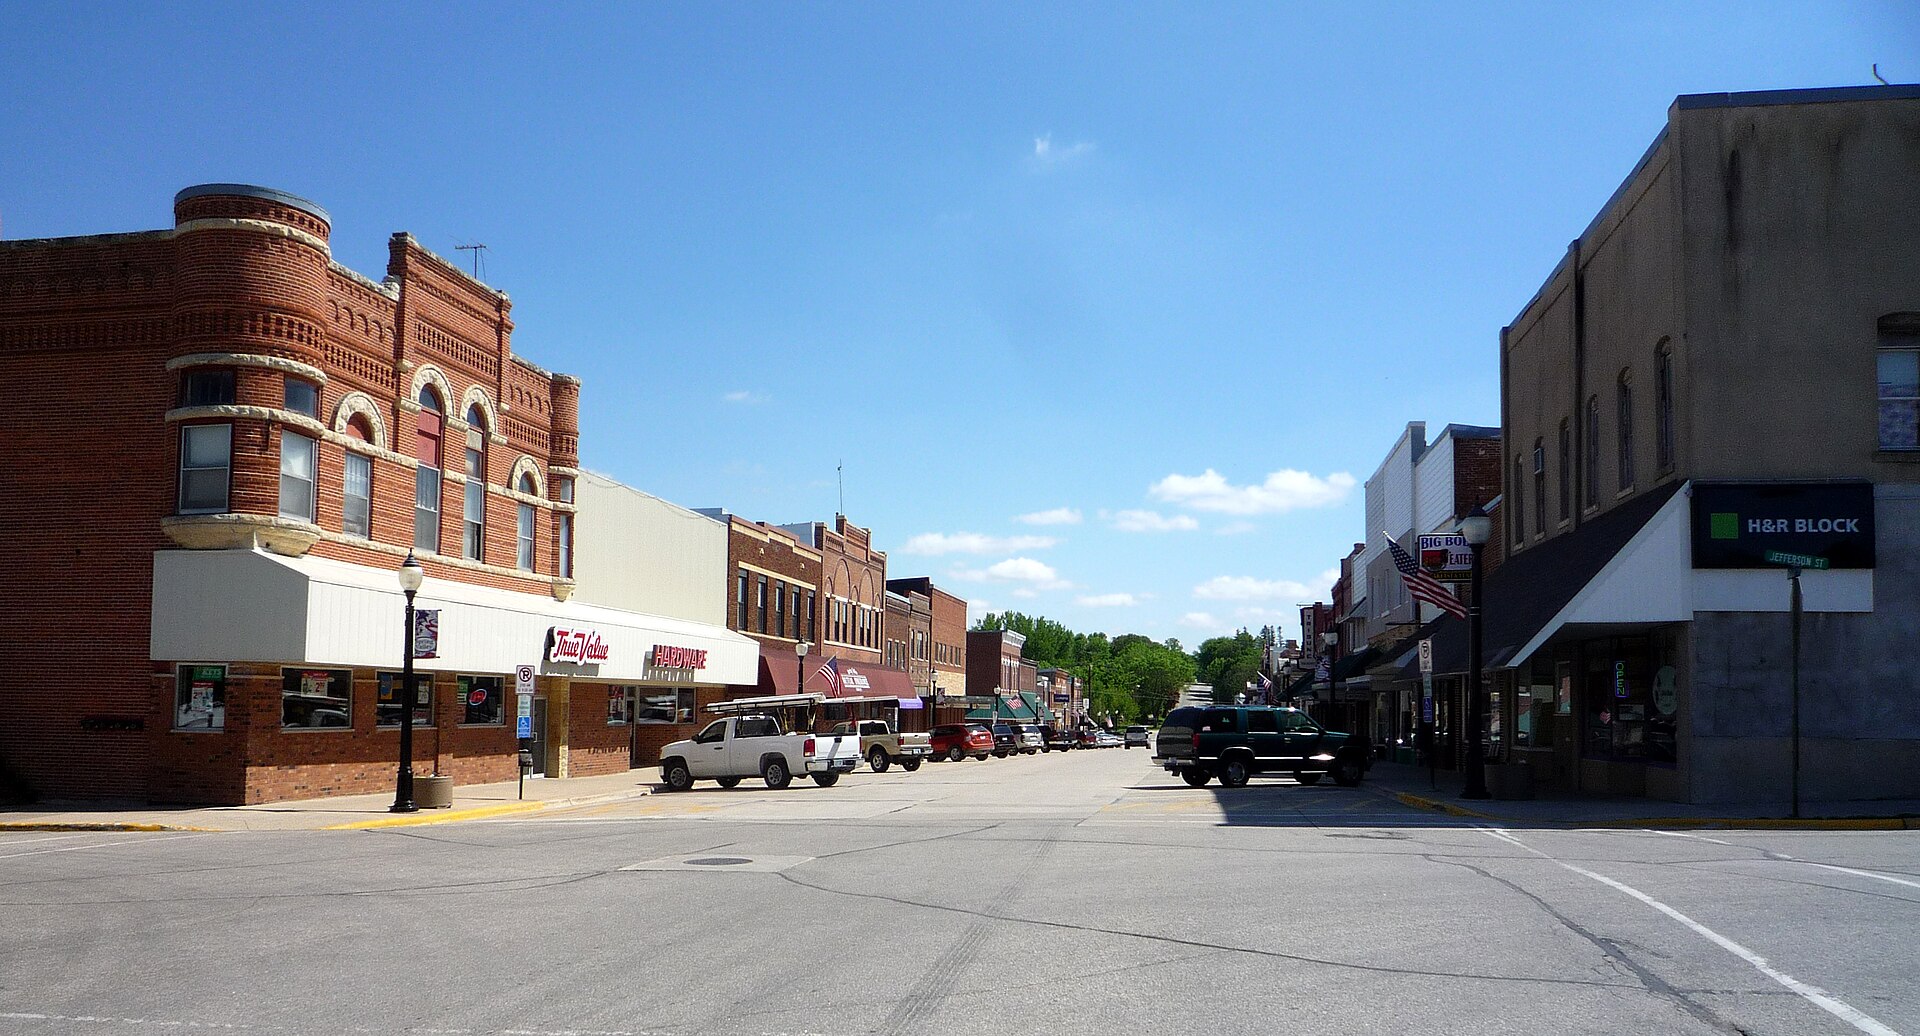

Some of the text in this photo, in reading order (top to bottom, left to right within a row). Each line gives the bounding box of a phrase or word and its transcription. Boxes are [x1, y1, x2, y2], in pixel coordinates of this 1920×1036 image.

[1747, 518, 1860, 533] H&R BLOCK
[1421, 537, 1441, 549] BIG
[1769, 551, 1825, 568] JEFFERSON ST
[552, 630, 609, 662] True Value
[653, 645, 708, 670] HARDWARE
[1615, 662, 1625, 695] OPEN
